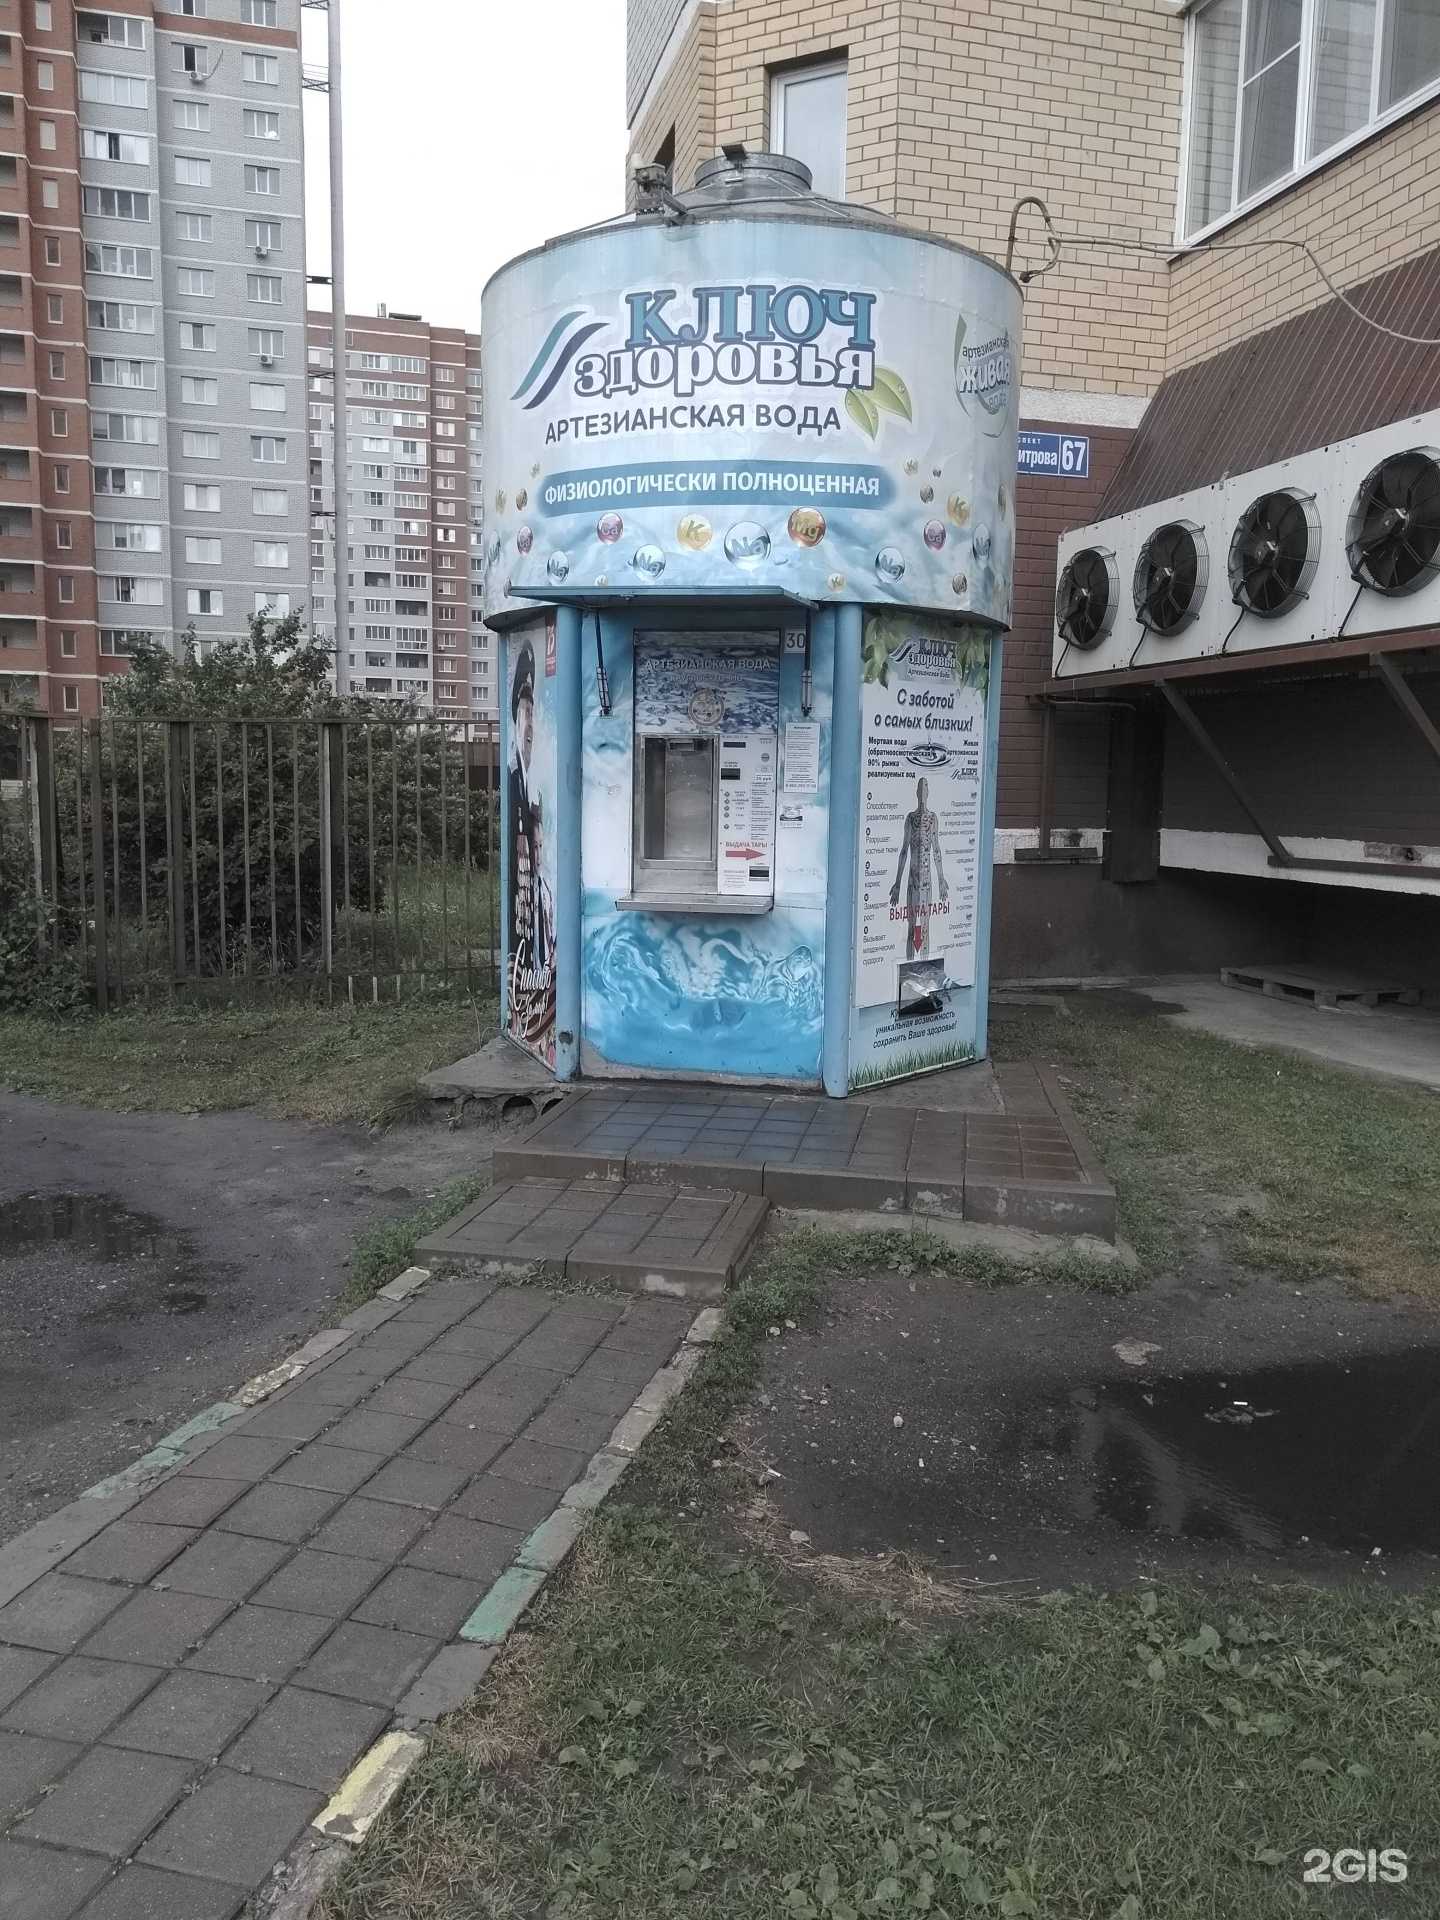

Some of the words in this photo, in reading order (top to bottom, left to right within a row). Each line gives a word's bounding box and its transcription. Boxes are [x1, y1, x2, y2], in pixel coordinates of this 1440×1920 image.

[625, 284, 877, 350] КЛЮЧ
[574, 341, 875, 399] здоровья
[545, 404, 745, 445] АРТЕЗИАНСКАЯ
[755, 404, 841, 436] ВОДА
[1062, 440, 1086, 471] 67
[545, 472, 717, 505] ФИЗИОЛОГИЧЕСКИ
[723, 472, 880, 497] ПОЛНОЦЕННАЯ
[793, 518, 822, 541] Mg
[786, 632, 805, 649] 30
[645, 659, 735, 671] АРТЕЗИАНСКАЯ
[740, 659, 771, 671] ВОДА
[897, 688, 907, 705] С
[908, 690, 955, 709] заботой
[874, 715, 882, 727] о
[884, 714, 922, 728] самых
[924, 712, 974, 732] близких!
[928, 901, 950, 917] ТАРЫ
